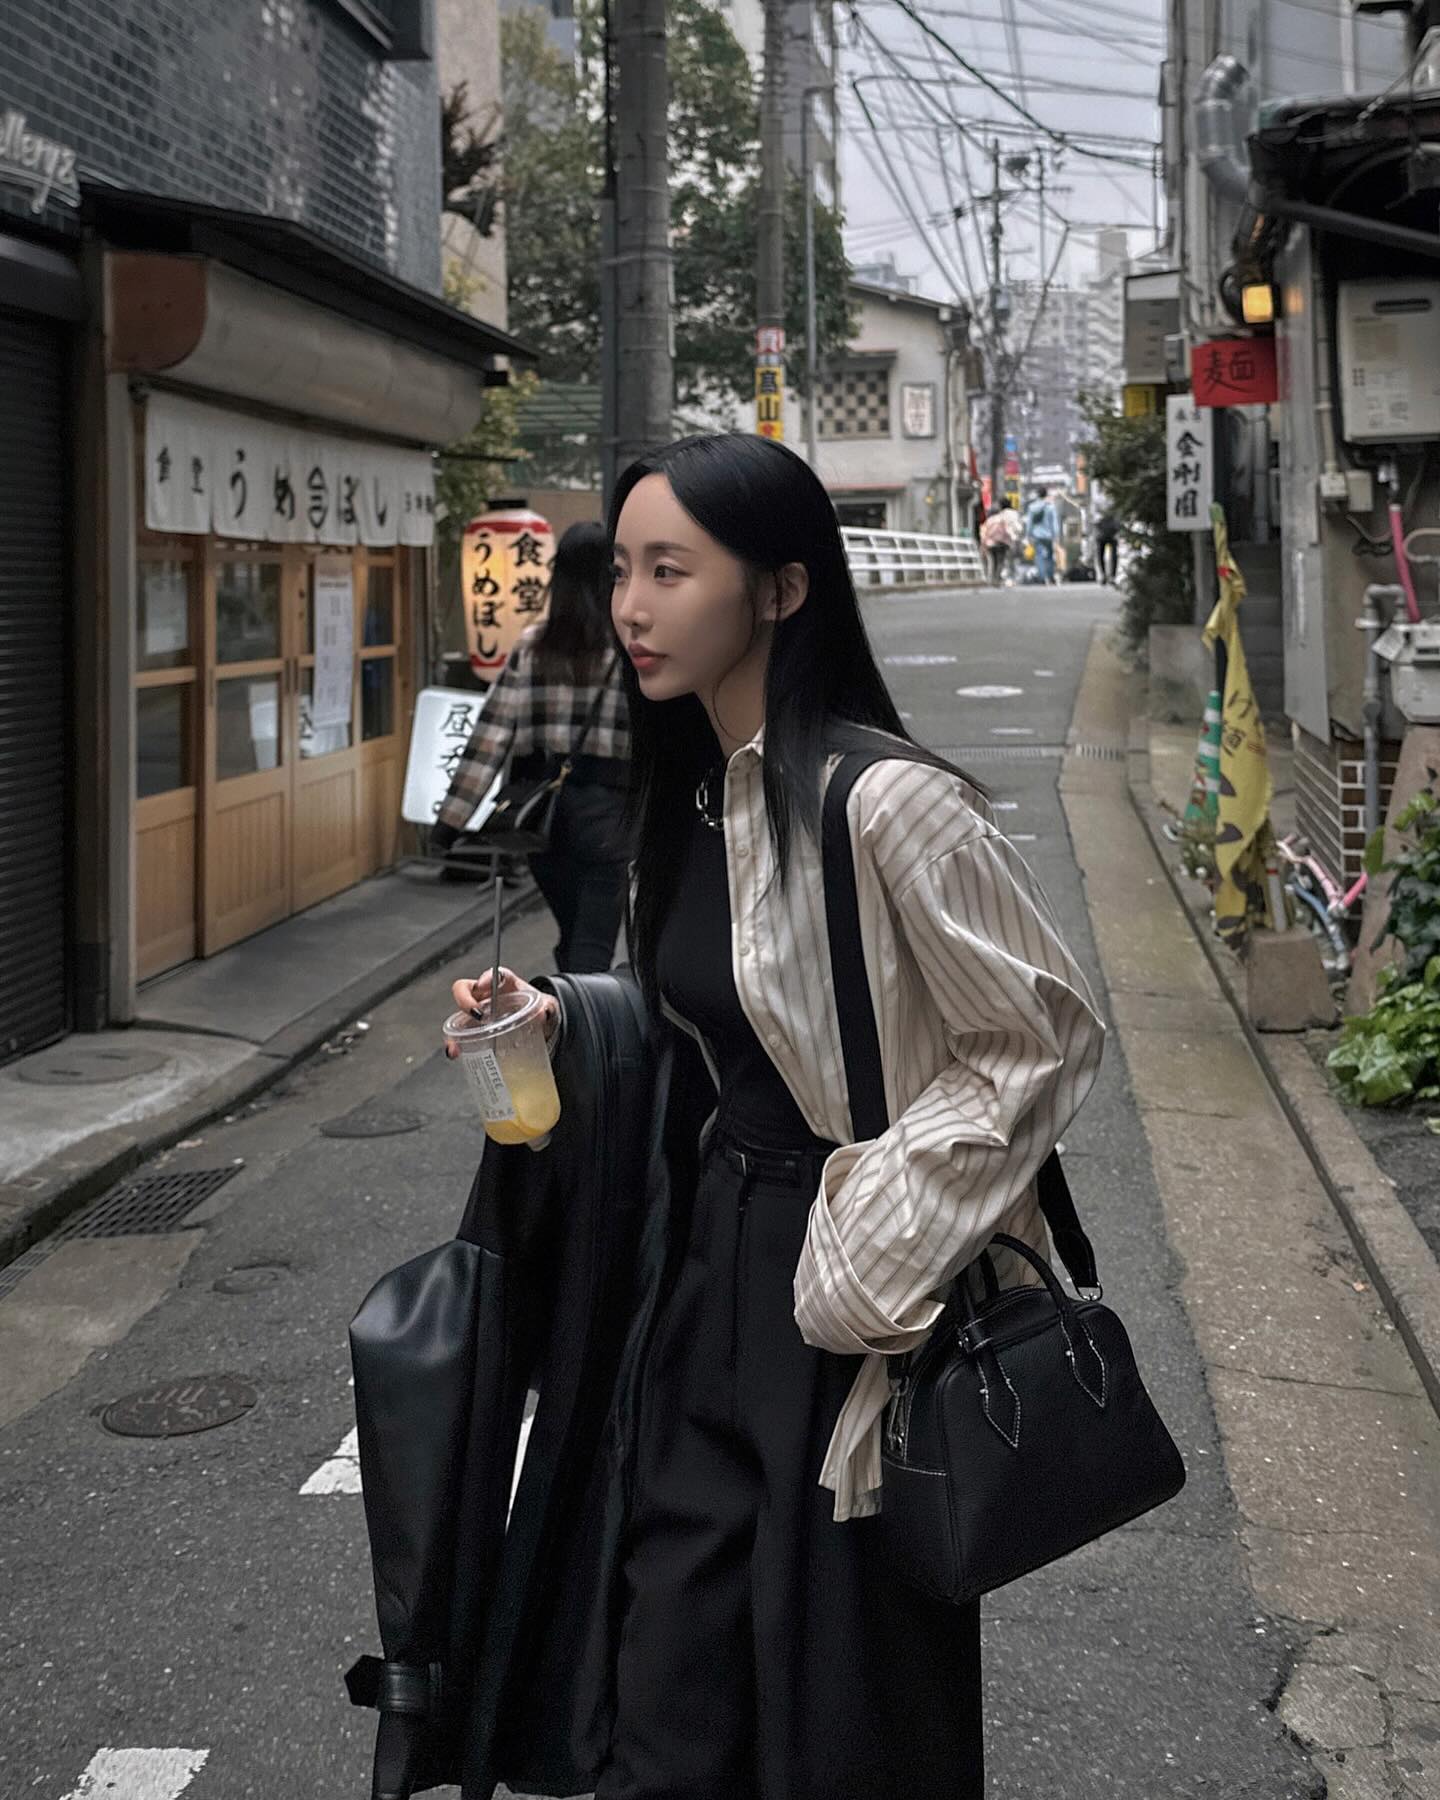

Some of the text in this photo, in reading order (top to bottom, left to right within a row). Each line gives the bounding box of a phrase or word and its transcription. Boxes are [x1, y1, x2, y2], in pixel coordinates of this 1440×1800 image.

[472, 532, 504, 659] うめぼし
[509, 532, 545, 614] 食堂
